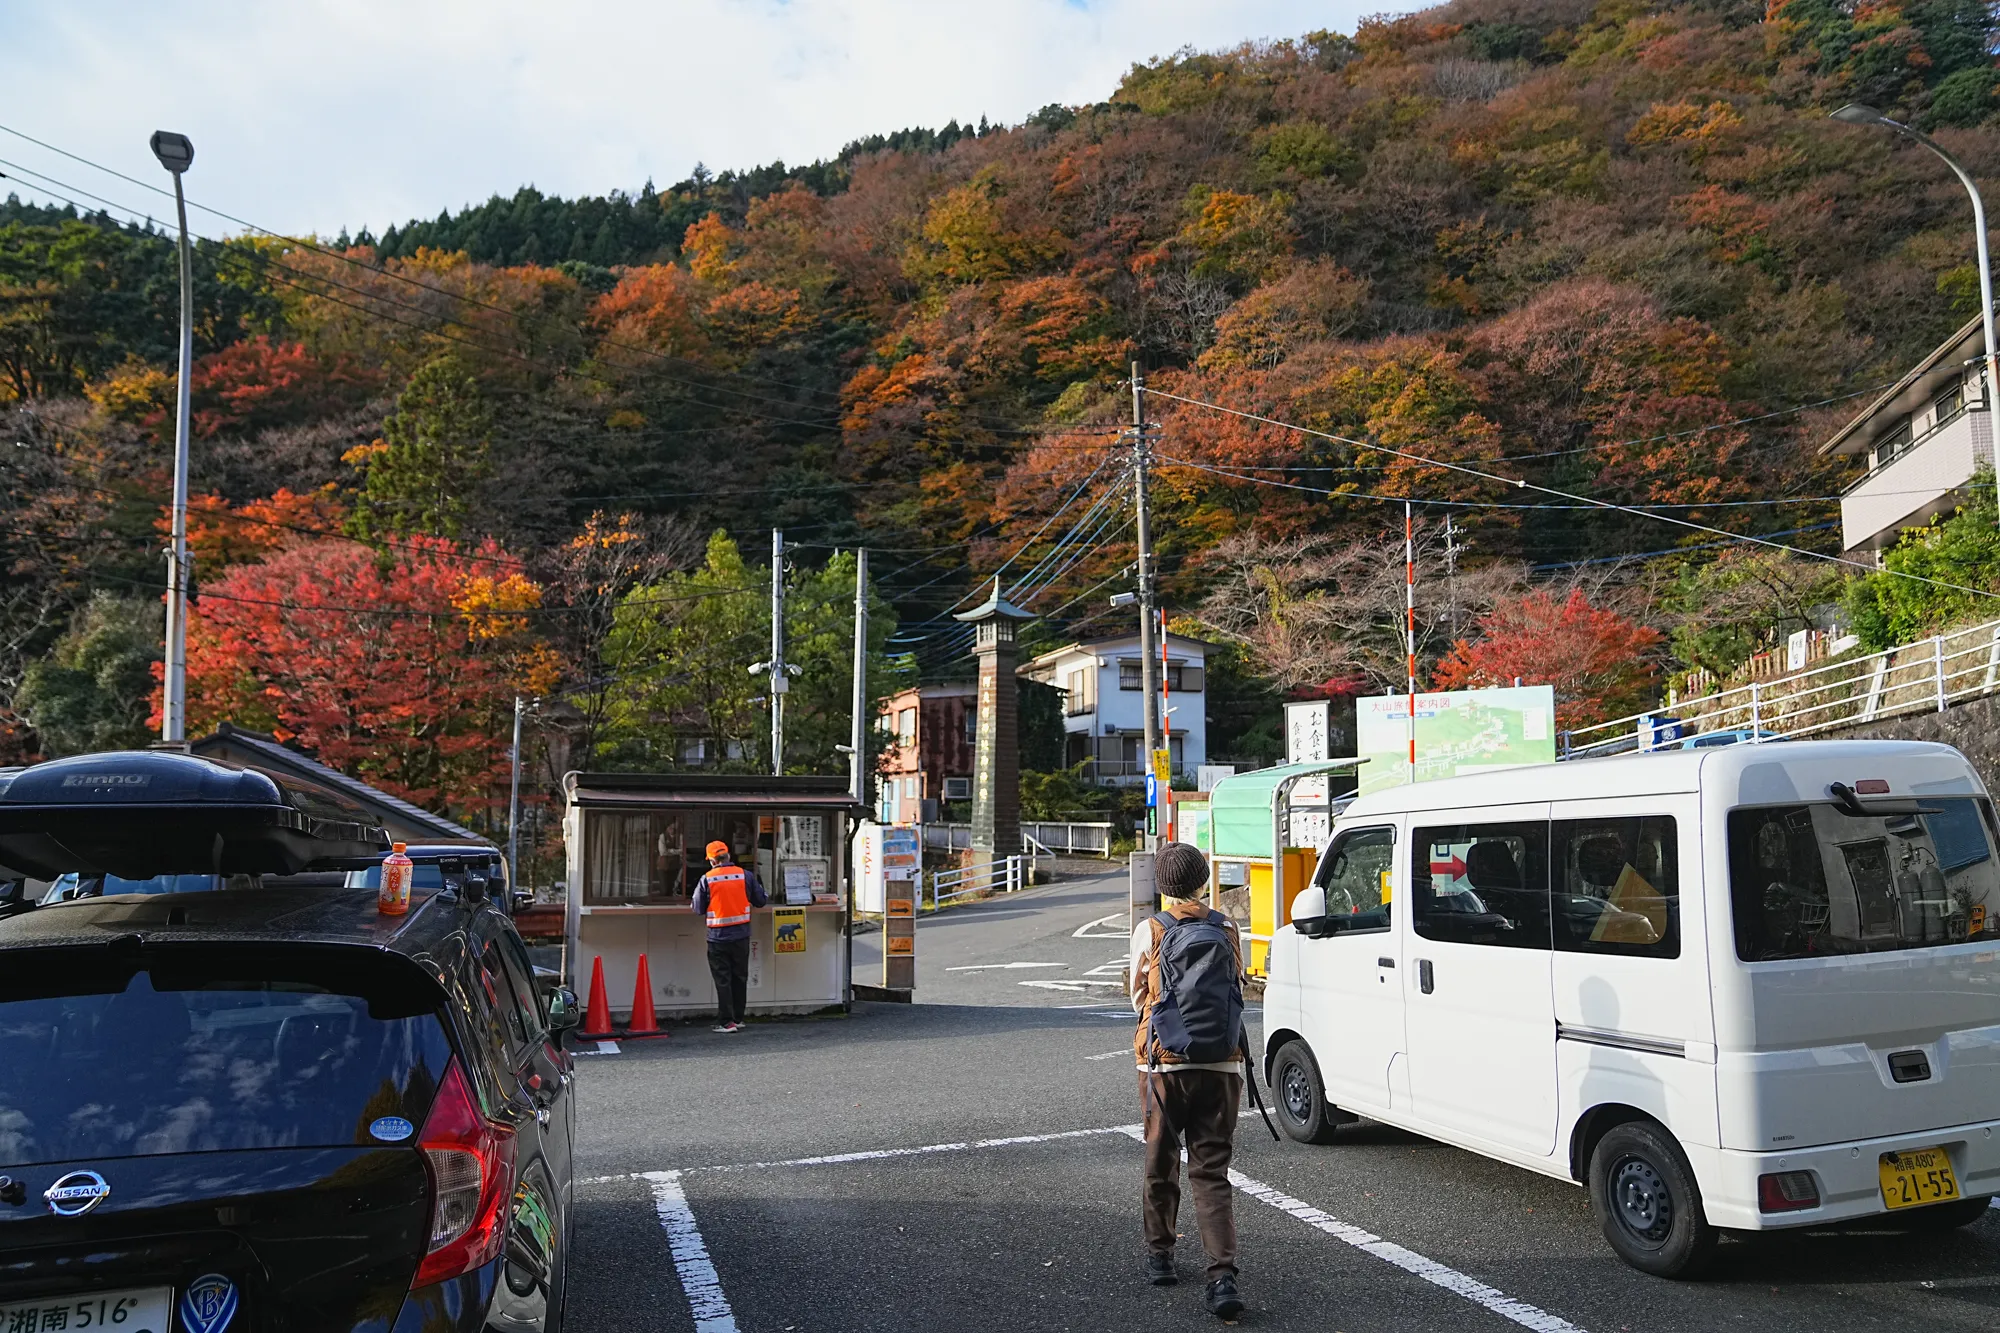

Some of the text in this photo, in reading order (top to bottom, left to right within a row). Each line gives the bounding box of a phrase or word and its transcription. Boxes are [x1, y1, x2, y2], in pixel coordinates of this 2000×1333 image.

[1147, 776, 1155, 805] P
[1915, 1154, 1933, 1168] 480
[50, 1188, 101, 1199] NISSAN
[1887, 1169, 1954, 1202] つ 21-55
[9, 1298, 129, 1333] 湘南 516
